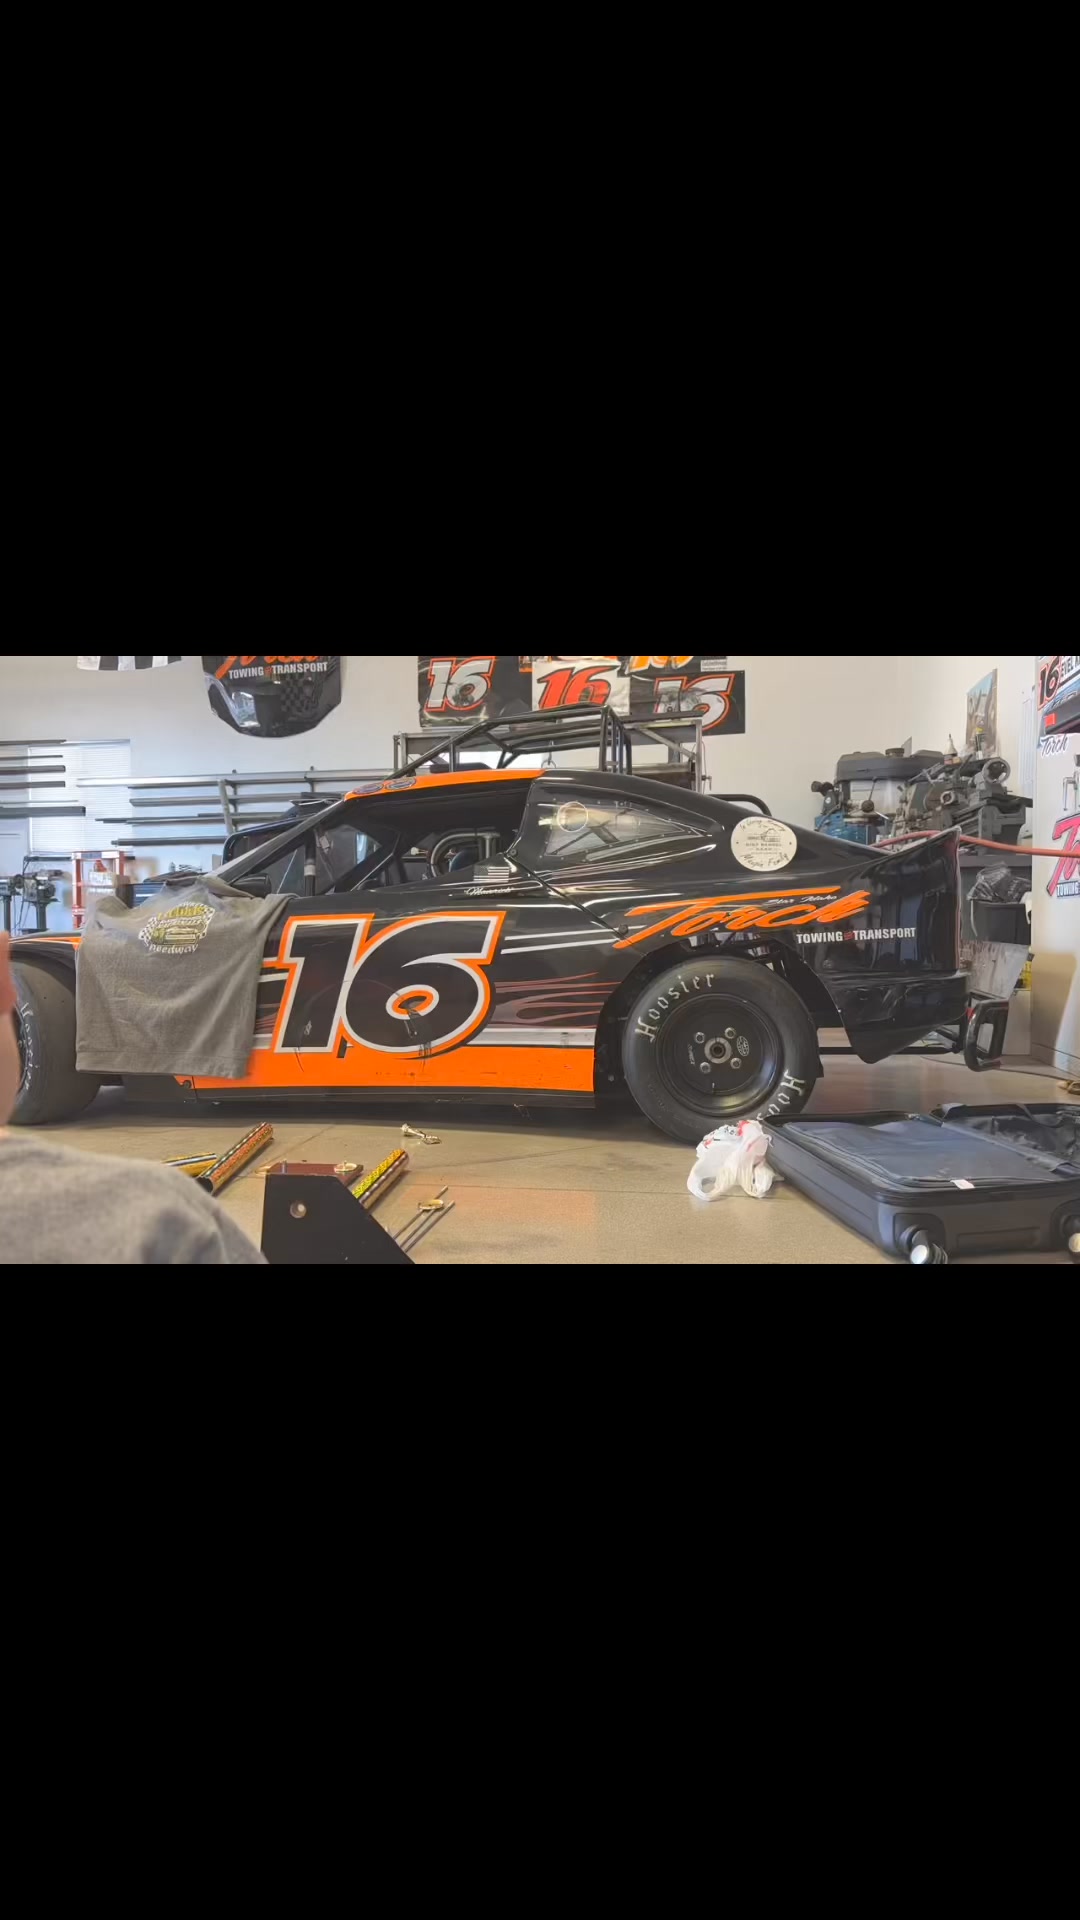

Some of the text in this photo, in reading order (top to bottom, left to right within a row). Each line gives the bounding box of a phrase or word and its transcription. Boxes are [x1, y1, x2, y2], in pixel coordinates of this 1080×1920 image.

[228, 666, 264, 680] TOWING
[271, 661, 328, 675] TRANSPORT
[424, 656, 496, 712] 16
[537, 665, 618, 712] 16
[1038, 656, 1060, 711] 16
[612, 886, 871, 949] Torch
[796, 931, 843, 944] TOWING
[853, 927, 917, 941] TRANSPORT
[270, 911, 507, 1059] 16
[634, 973, 715, 1043] Hoosier
